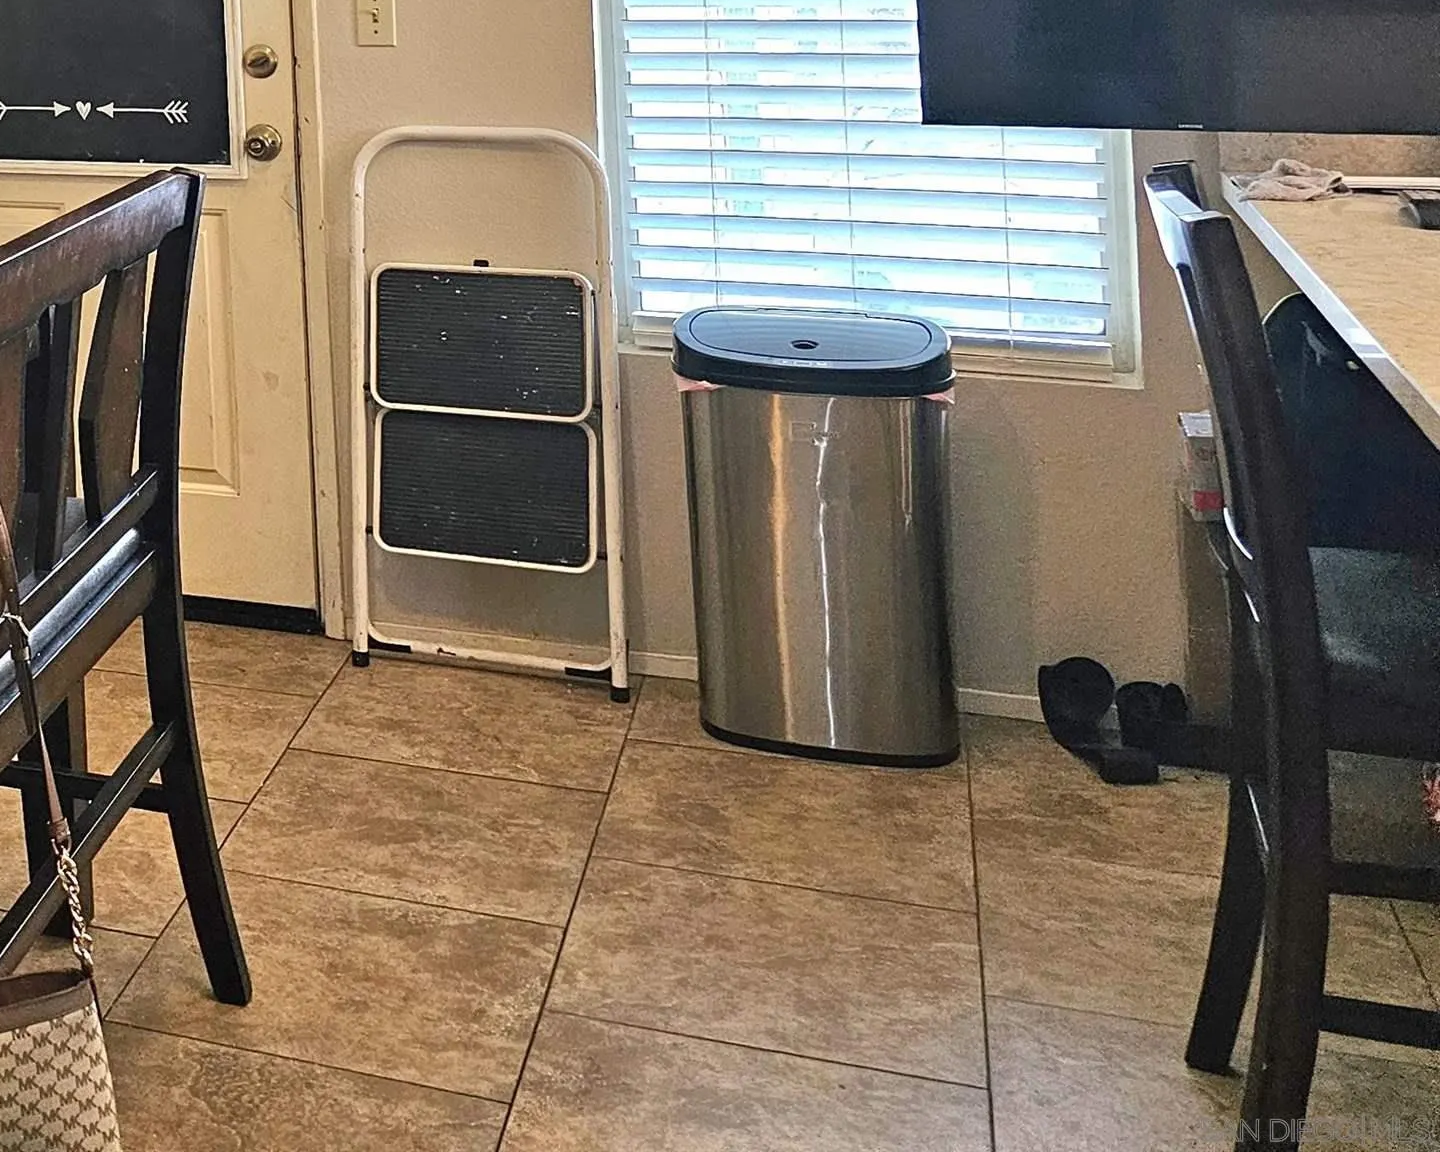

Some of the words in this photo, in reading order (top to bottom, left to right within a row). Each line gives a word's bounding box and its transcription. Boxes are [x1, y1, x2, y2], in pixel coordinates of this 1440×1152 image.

[69, 1021, 88, 1036] MK
[32, 1033, 51, 1048] MK
[54, 1039, 73, 1054] MK
[15, 1051, 36, 1066] MK
[72, 1046, 91, 1061] MK
[36, 1059, 55, 1074] MK
[57, 1065, 76, 1080] MK
[19, 1077, 40, 1092] MK
[76, 1071, 95, 1086] MK
[39, 1084, 58, 1099] MK
[60, 1090, 79, 1105] MK
[0, 1093, 21, 1108] MK
[79, 1096, 98, 1111] MK
[22, 1101, 43, 1116] MK
[42, 1109, 61, 1124] MK
[64, 1115, 83, 1130] MK
[83, 1121, 102, 1136] MK
[47, 1133, 66, 1148] MK
